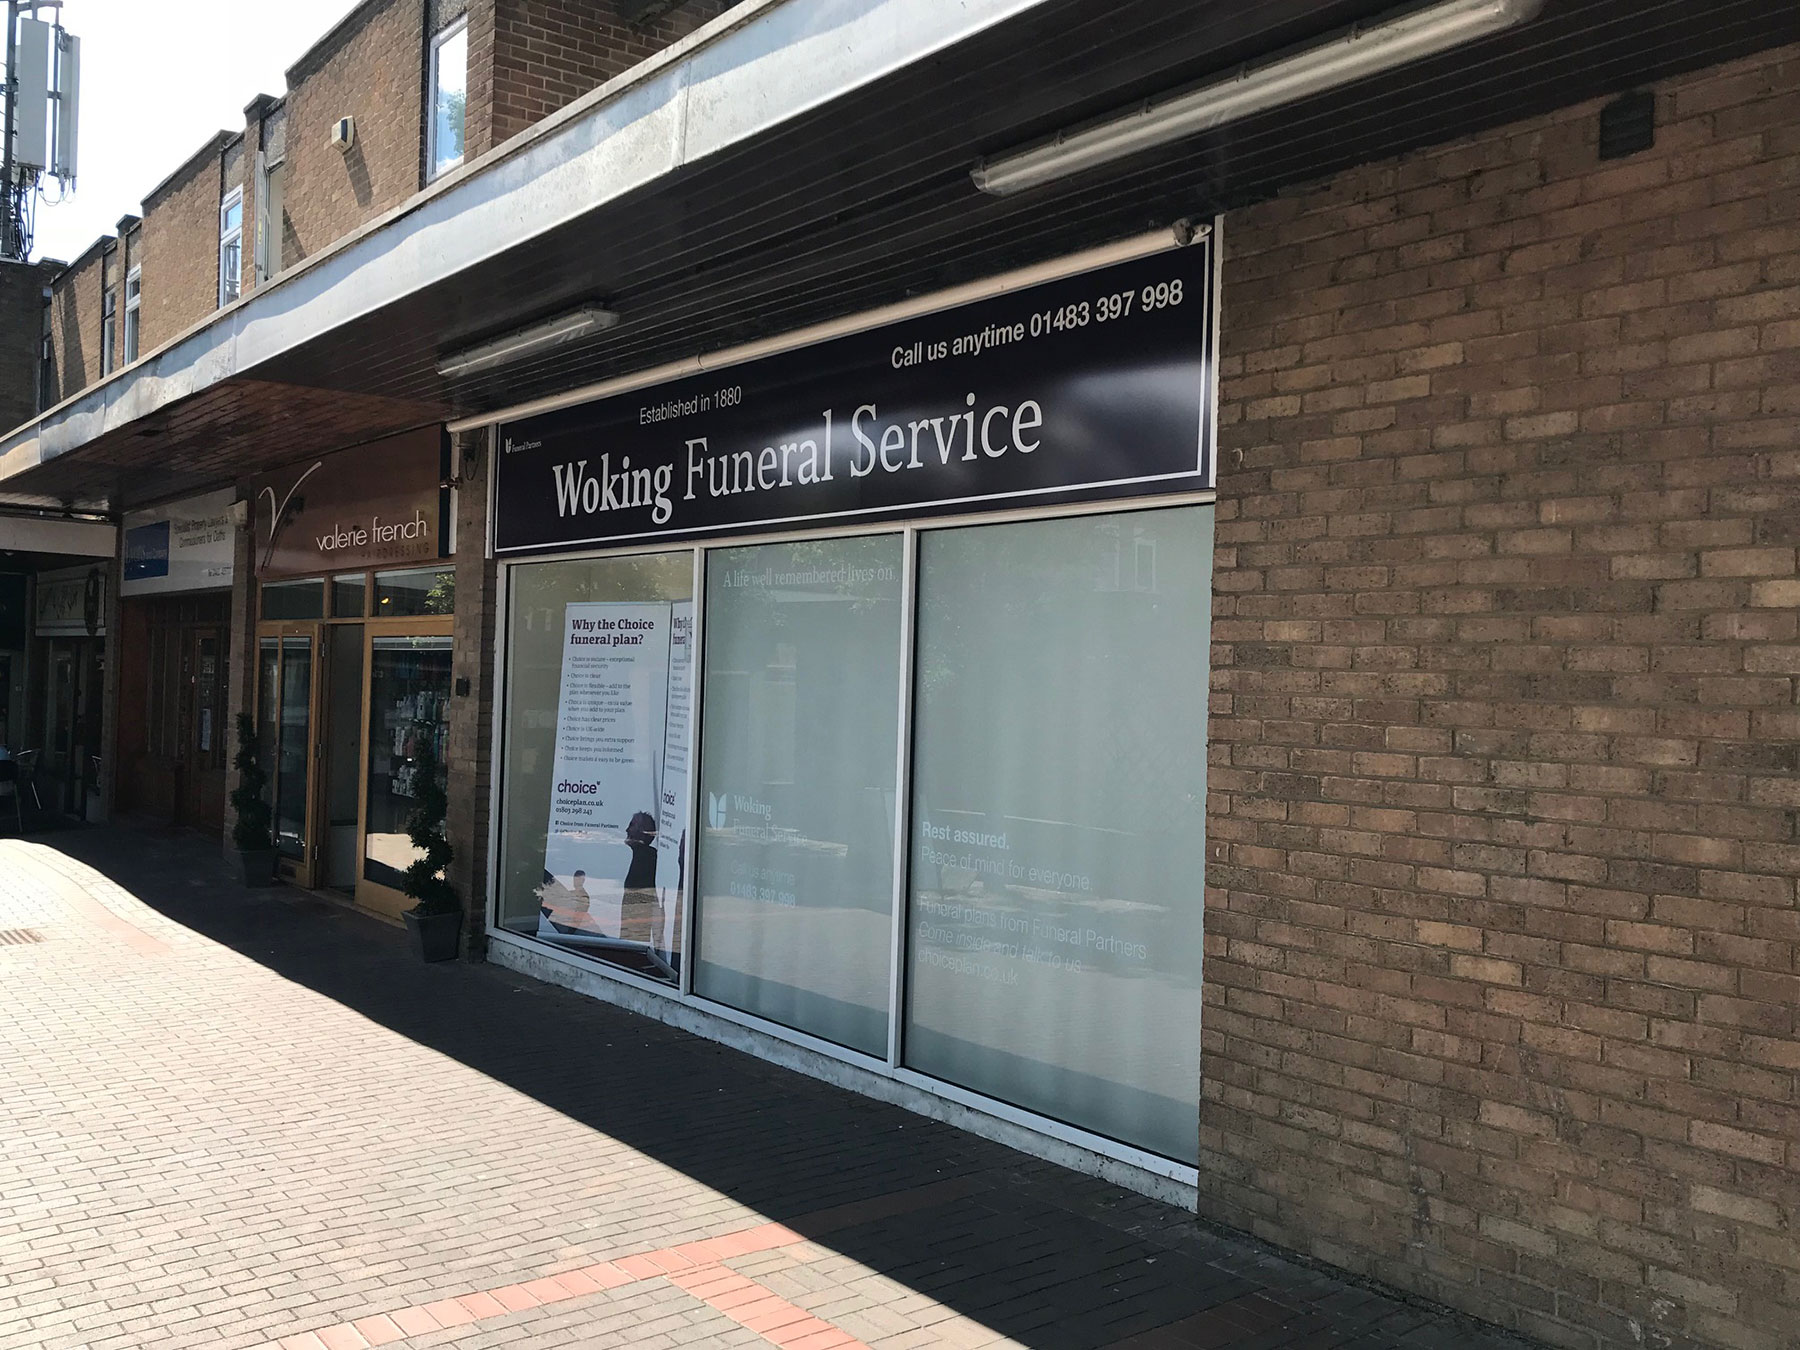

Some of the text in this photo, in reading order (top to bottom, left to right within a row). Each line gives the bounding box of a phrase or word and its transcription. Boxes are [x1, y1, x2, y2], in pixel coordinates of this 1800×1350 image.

[891, 279, 1184, 368] Call us anytime 01483 397 998
[640, 386, 742, 424] Established in 1880
[552, 392, 1043, 524] Woking Funeral Service
[316, 510, 427, 550] valerie french
[722, 572, 732, 587] A
[734, 570, 750, 587] life
[752, 568, 772, 586] well
[774, 565, 844, 585] remembered
[846, 565, 874, 582] lives
[572, 618, 654, 632] Why the Choice
[570, 634, 644, 647] funeral plan?
[557, 779, 597, 794] choice
[556, 798, 604, 806] choiceplan.co.uk
[734, 795, 772, 820] Woking
[733, 818, 769, 841] Funeral
[922, 821, 1010, 850] Rest assured.
[921, 846, 1092, 891] Peace of mind for everyone.
[730, 880, 796, 908] 01483 397 998
[920, 897, 1147, 960] Funeral plans from Funeral Partners
[919, 921, 954, 944] Come
[956, 931, 990, 952] inside
[993, 938, 1017, 959] and
[1065, 958, 1082, 973] us
[918, 946, 1018, 985] choiceplan.co.uk
